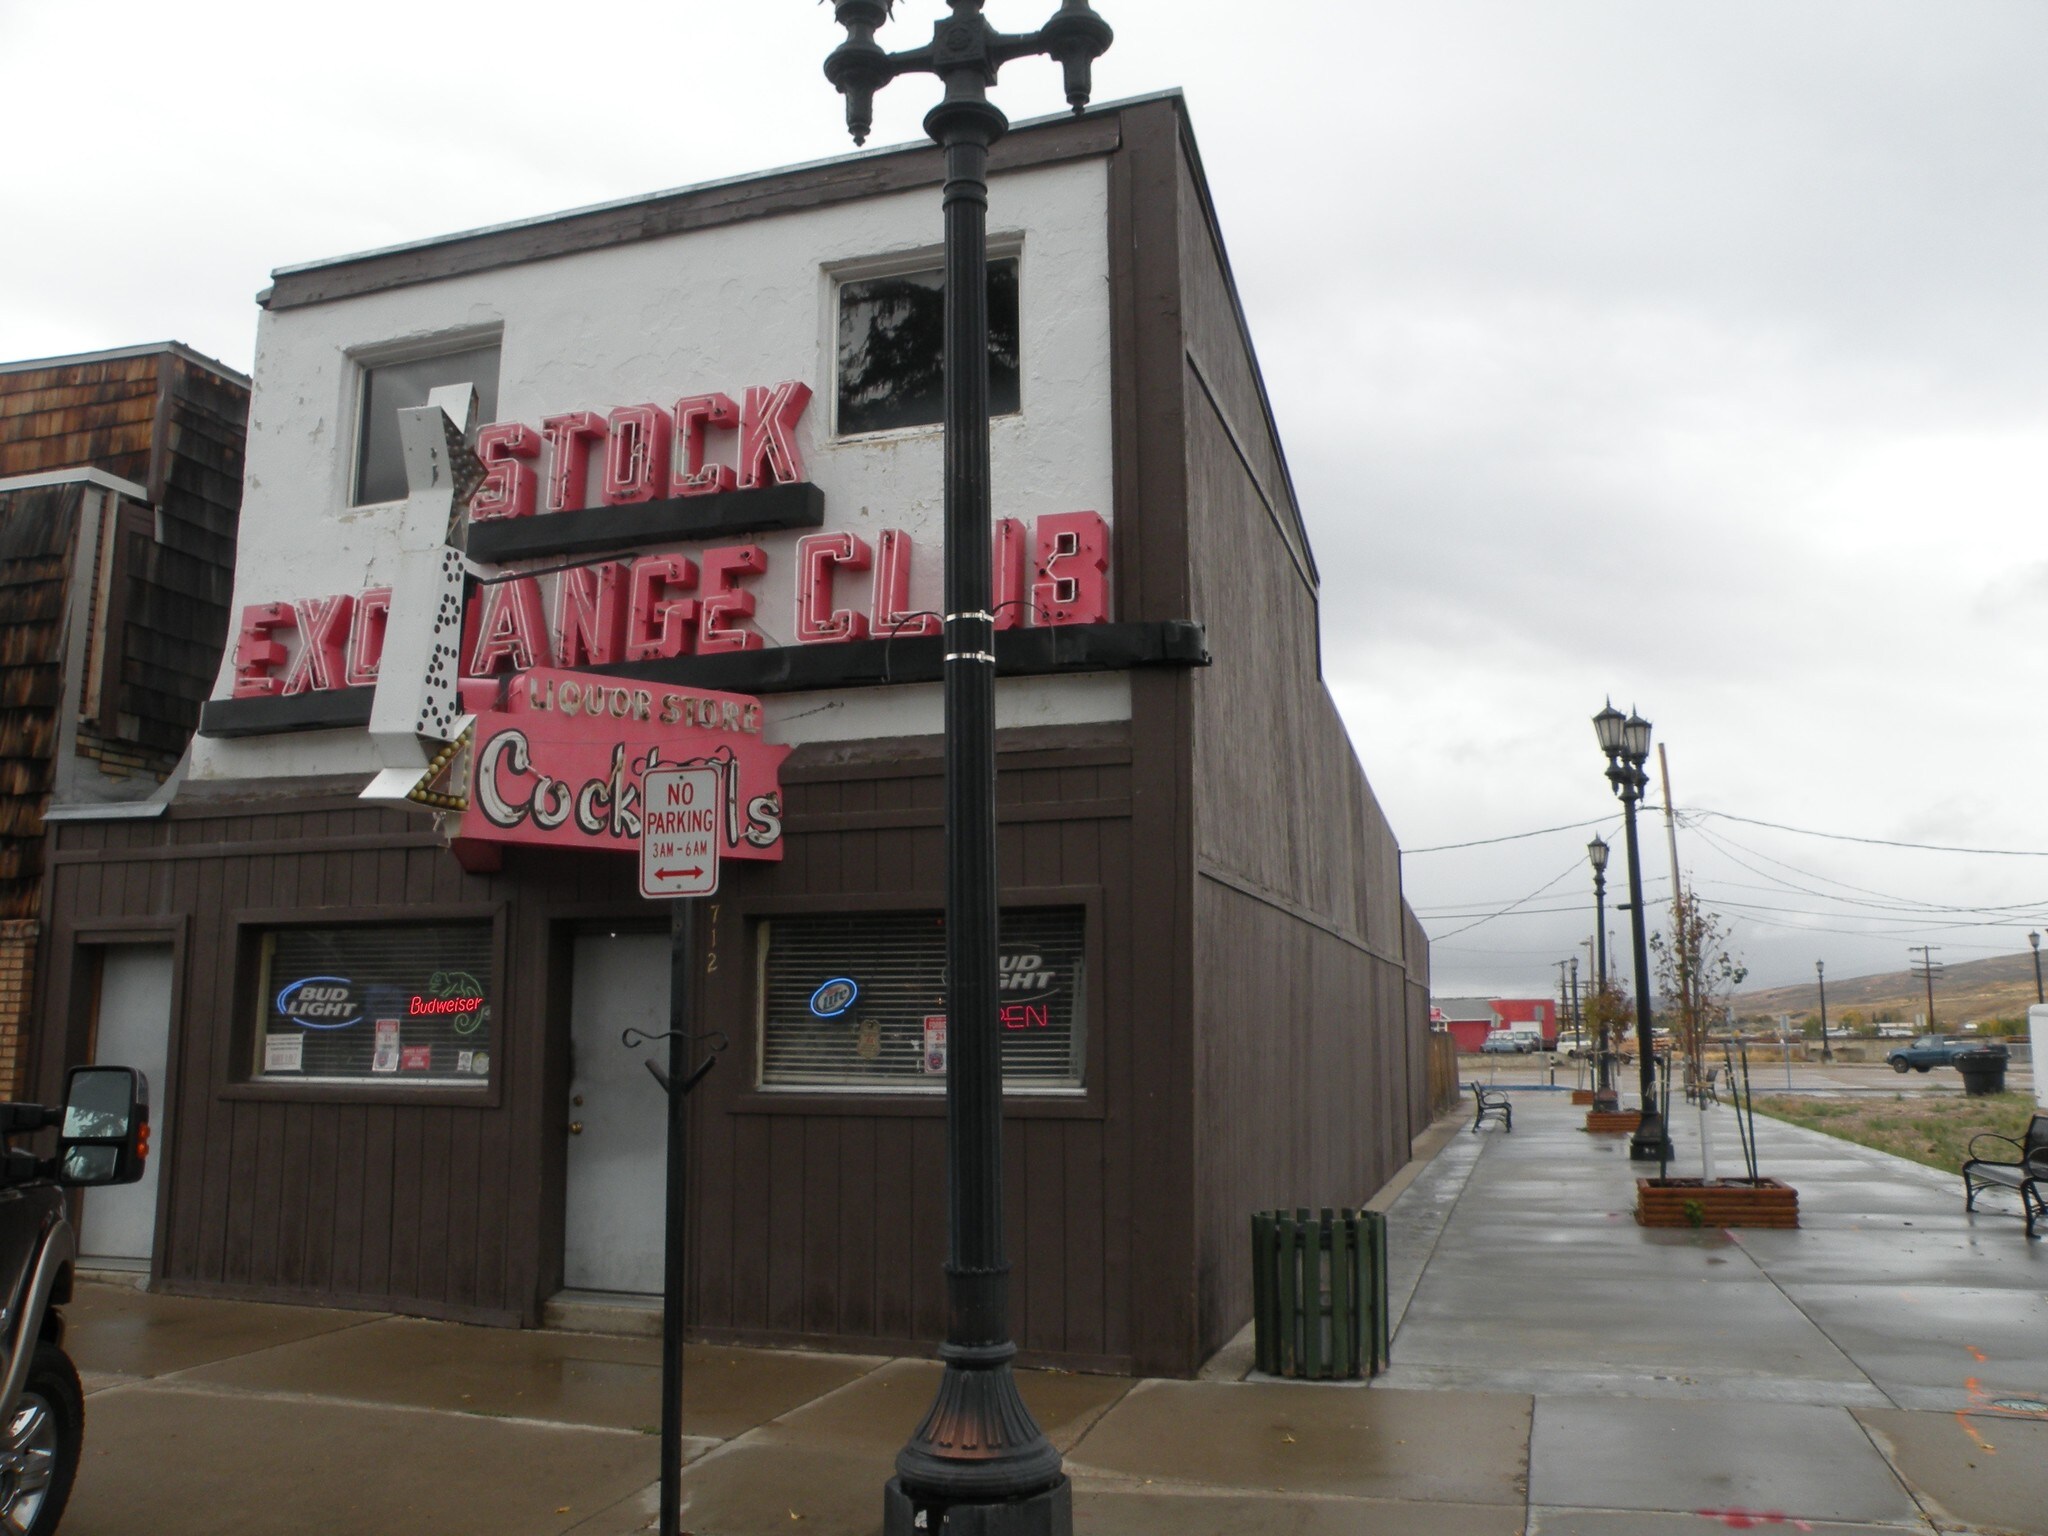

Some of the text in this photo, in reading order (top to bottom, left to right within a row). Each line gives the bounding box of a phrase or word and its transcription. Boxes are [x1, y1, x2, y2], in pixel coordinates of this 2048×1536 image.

[470, 380, 814, 522] STOCK
[231, 545, 768, 698] EXCANGE
[530, 678, 761, 734] LIQUOR STORE
[475, 728, 783, 848] Cockls
[667, 782, 694, 806] NO
[647, 809, 713, 835] PARKING
[999, 954, 1042, 973] UD
[999, 971, 1056, 990] GHT
[298, 986, 349, 1002] BUD
[408, 995, 484, 1016] Budweiser
[287, 1001, 358, 1017] LIGHT
